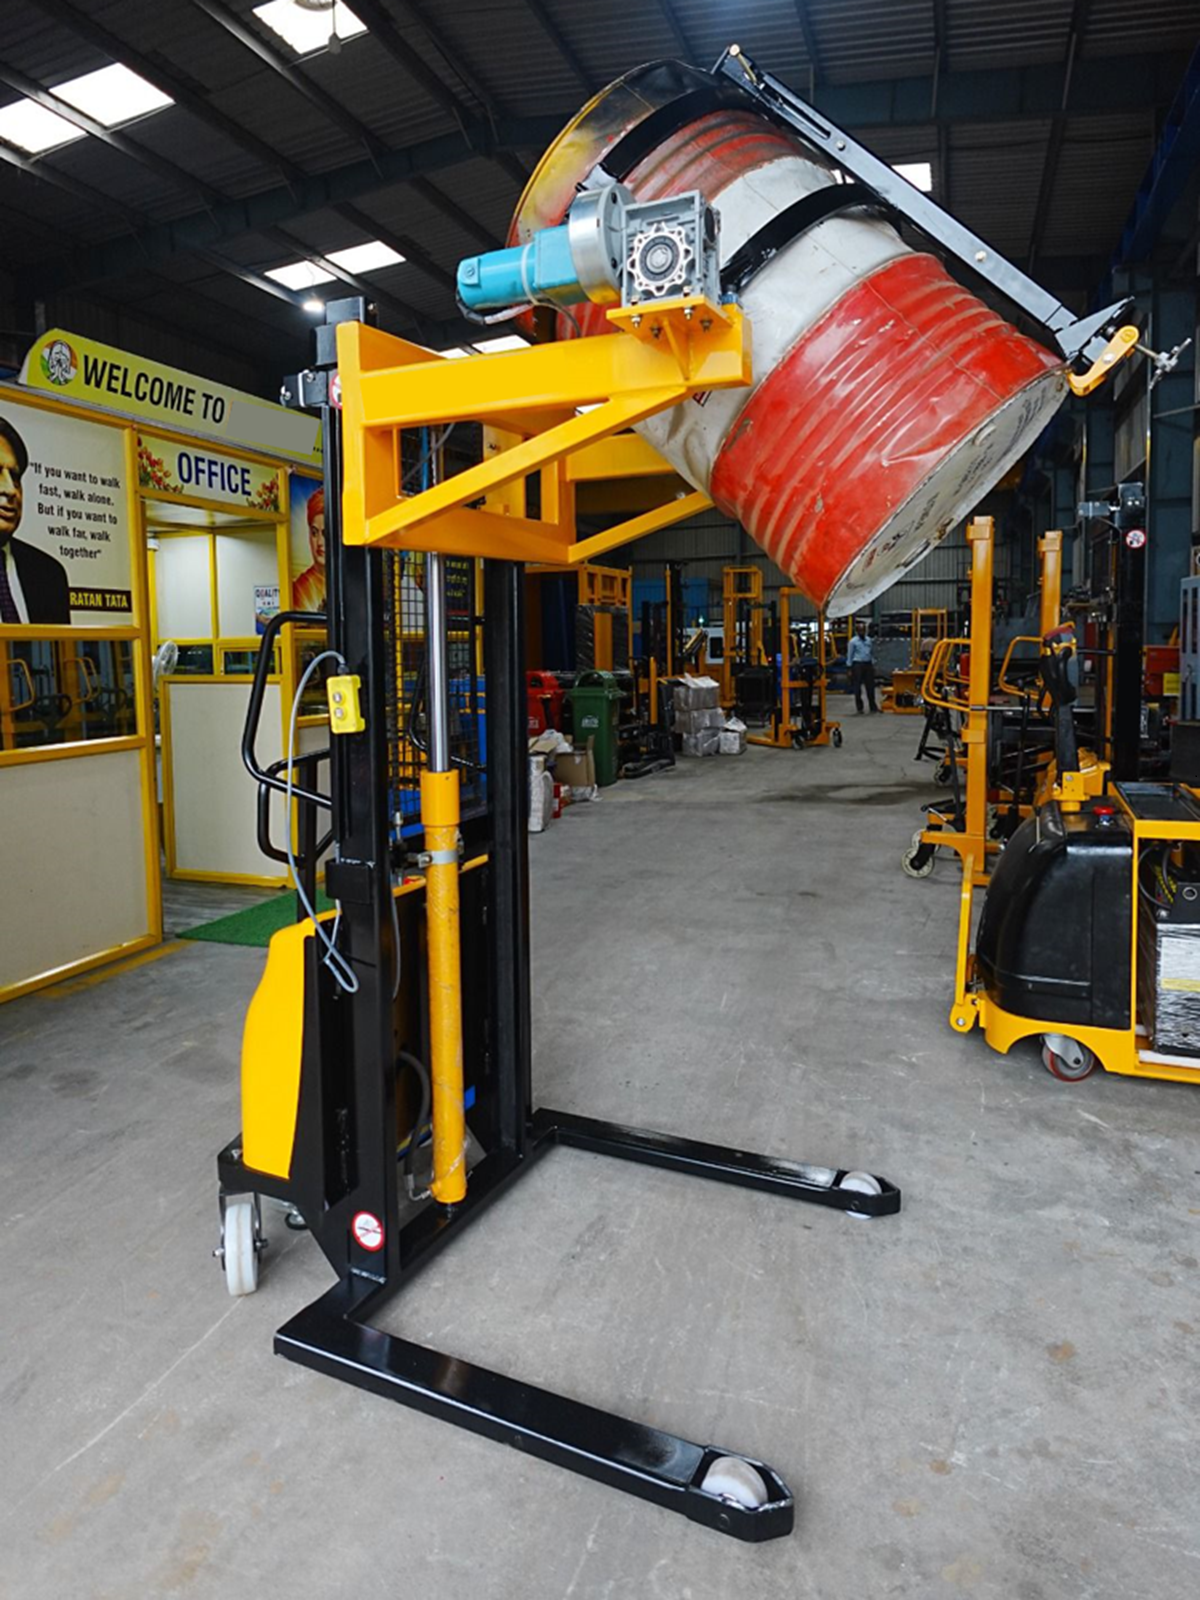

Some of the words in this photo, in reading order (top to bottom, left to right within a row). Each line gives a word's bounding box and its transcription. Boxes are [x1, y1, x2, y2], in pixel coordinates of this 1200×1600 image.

[83, 354, 196, 416] WELCOME
[202, 393, 226, 424] TO
[44, 466, 62, 478] you
[64, 470, 87, 483] want
[88, 473, 99, 485] to
[100, 477, 121, 489] walk
[177, 452, 251, 496] OFFICE
[39, 483, 62, 499] fast,
[63, 489, 86, 502] walk
[87, 493, 115, 506] alone.
[37, 502, 55, 516] But
[57, 505, 64, 517] if
[66, 509, 83, 520] you
[84, 511, 107, 523] want
[108, 513, 118, 525] to
[47, 525, 70, 537] walk
[72, 527, 88, 540] far,
[89, 530, 111, 542] walk
[70, 591, 103, 607] RATAN
[105, 593, 129, 608] TATA
